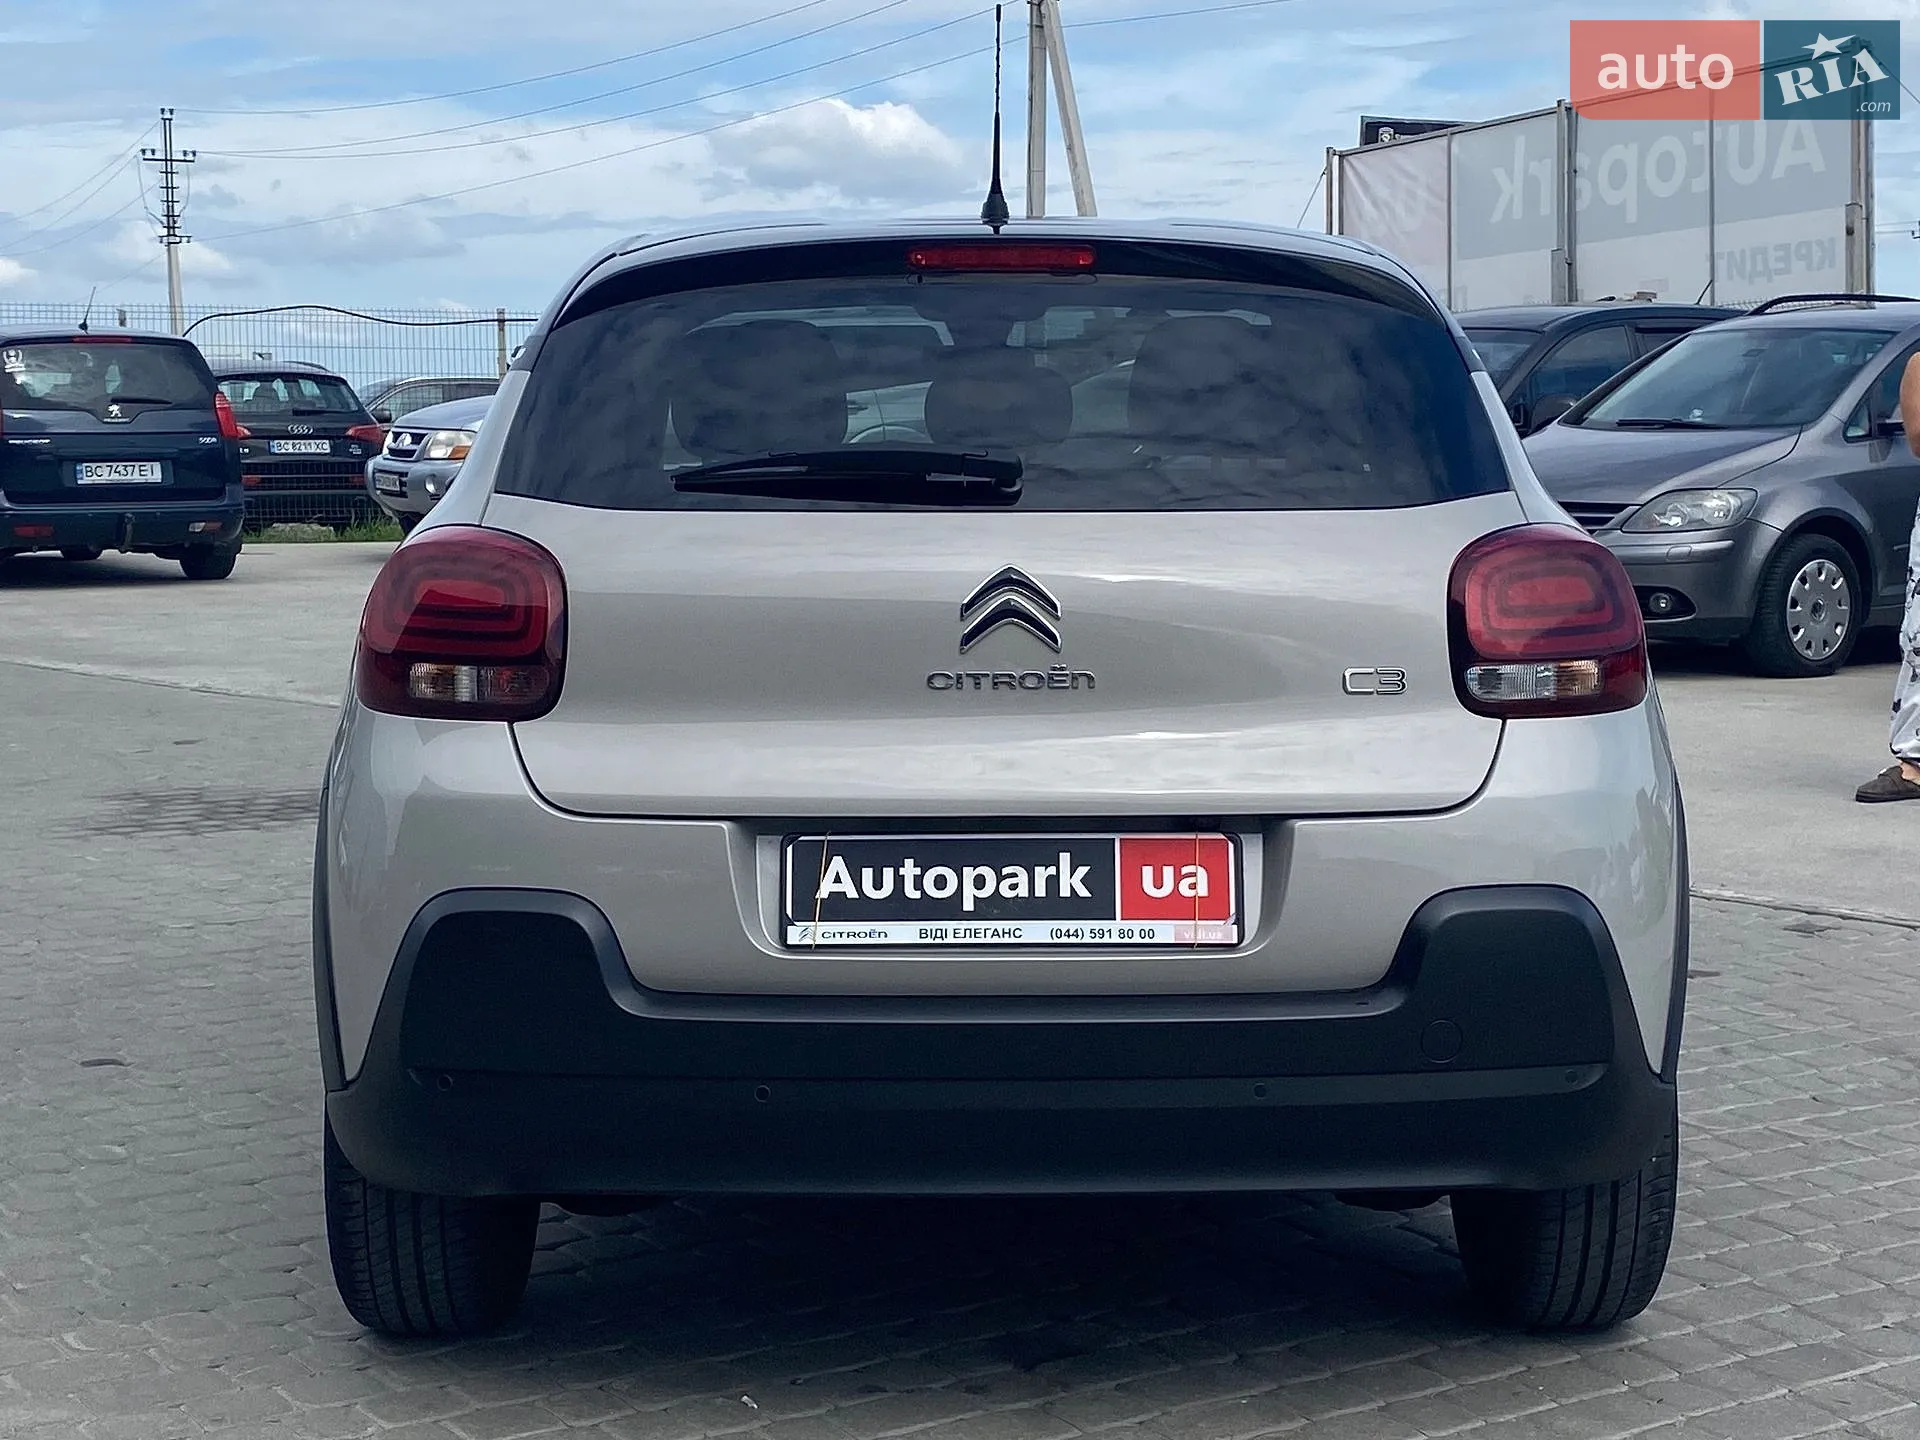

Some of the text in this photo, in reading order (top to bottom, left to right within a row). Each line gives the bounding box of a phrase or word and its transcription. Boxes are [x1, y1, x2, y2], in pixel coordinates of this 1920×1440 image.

[85, 465, 104, 478] BC
[107, 464, 136, 478] 7437
[1342, 665, 1408, 696] C3
[815, 851, 1209, 911] Autopark ua
[918, 927, 1023, 941] ВІДІ ЕЛЕГАНС
[1050, 928, 1156, 941] (044) 591 80 00
